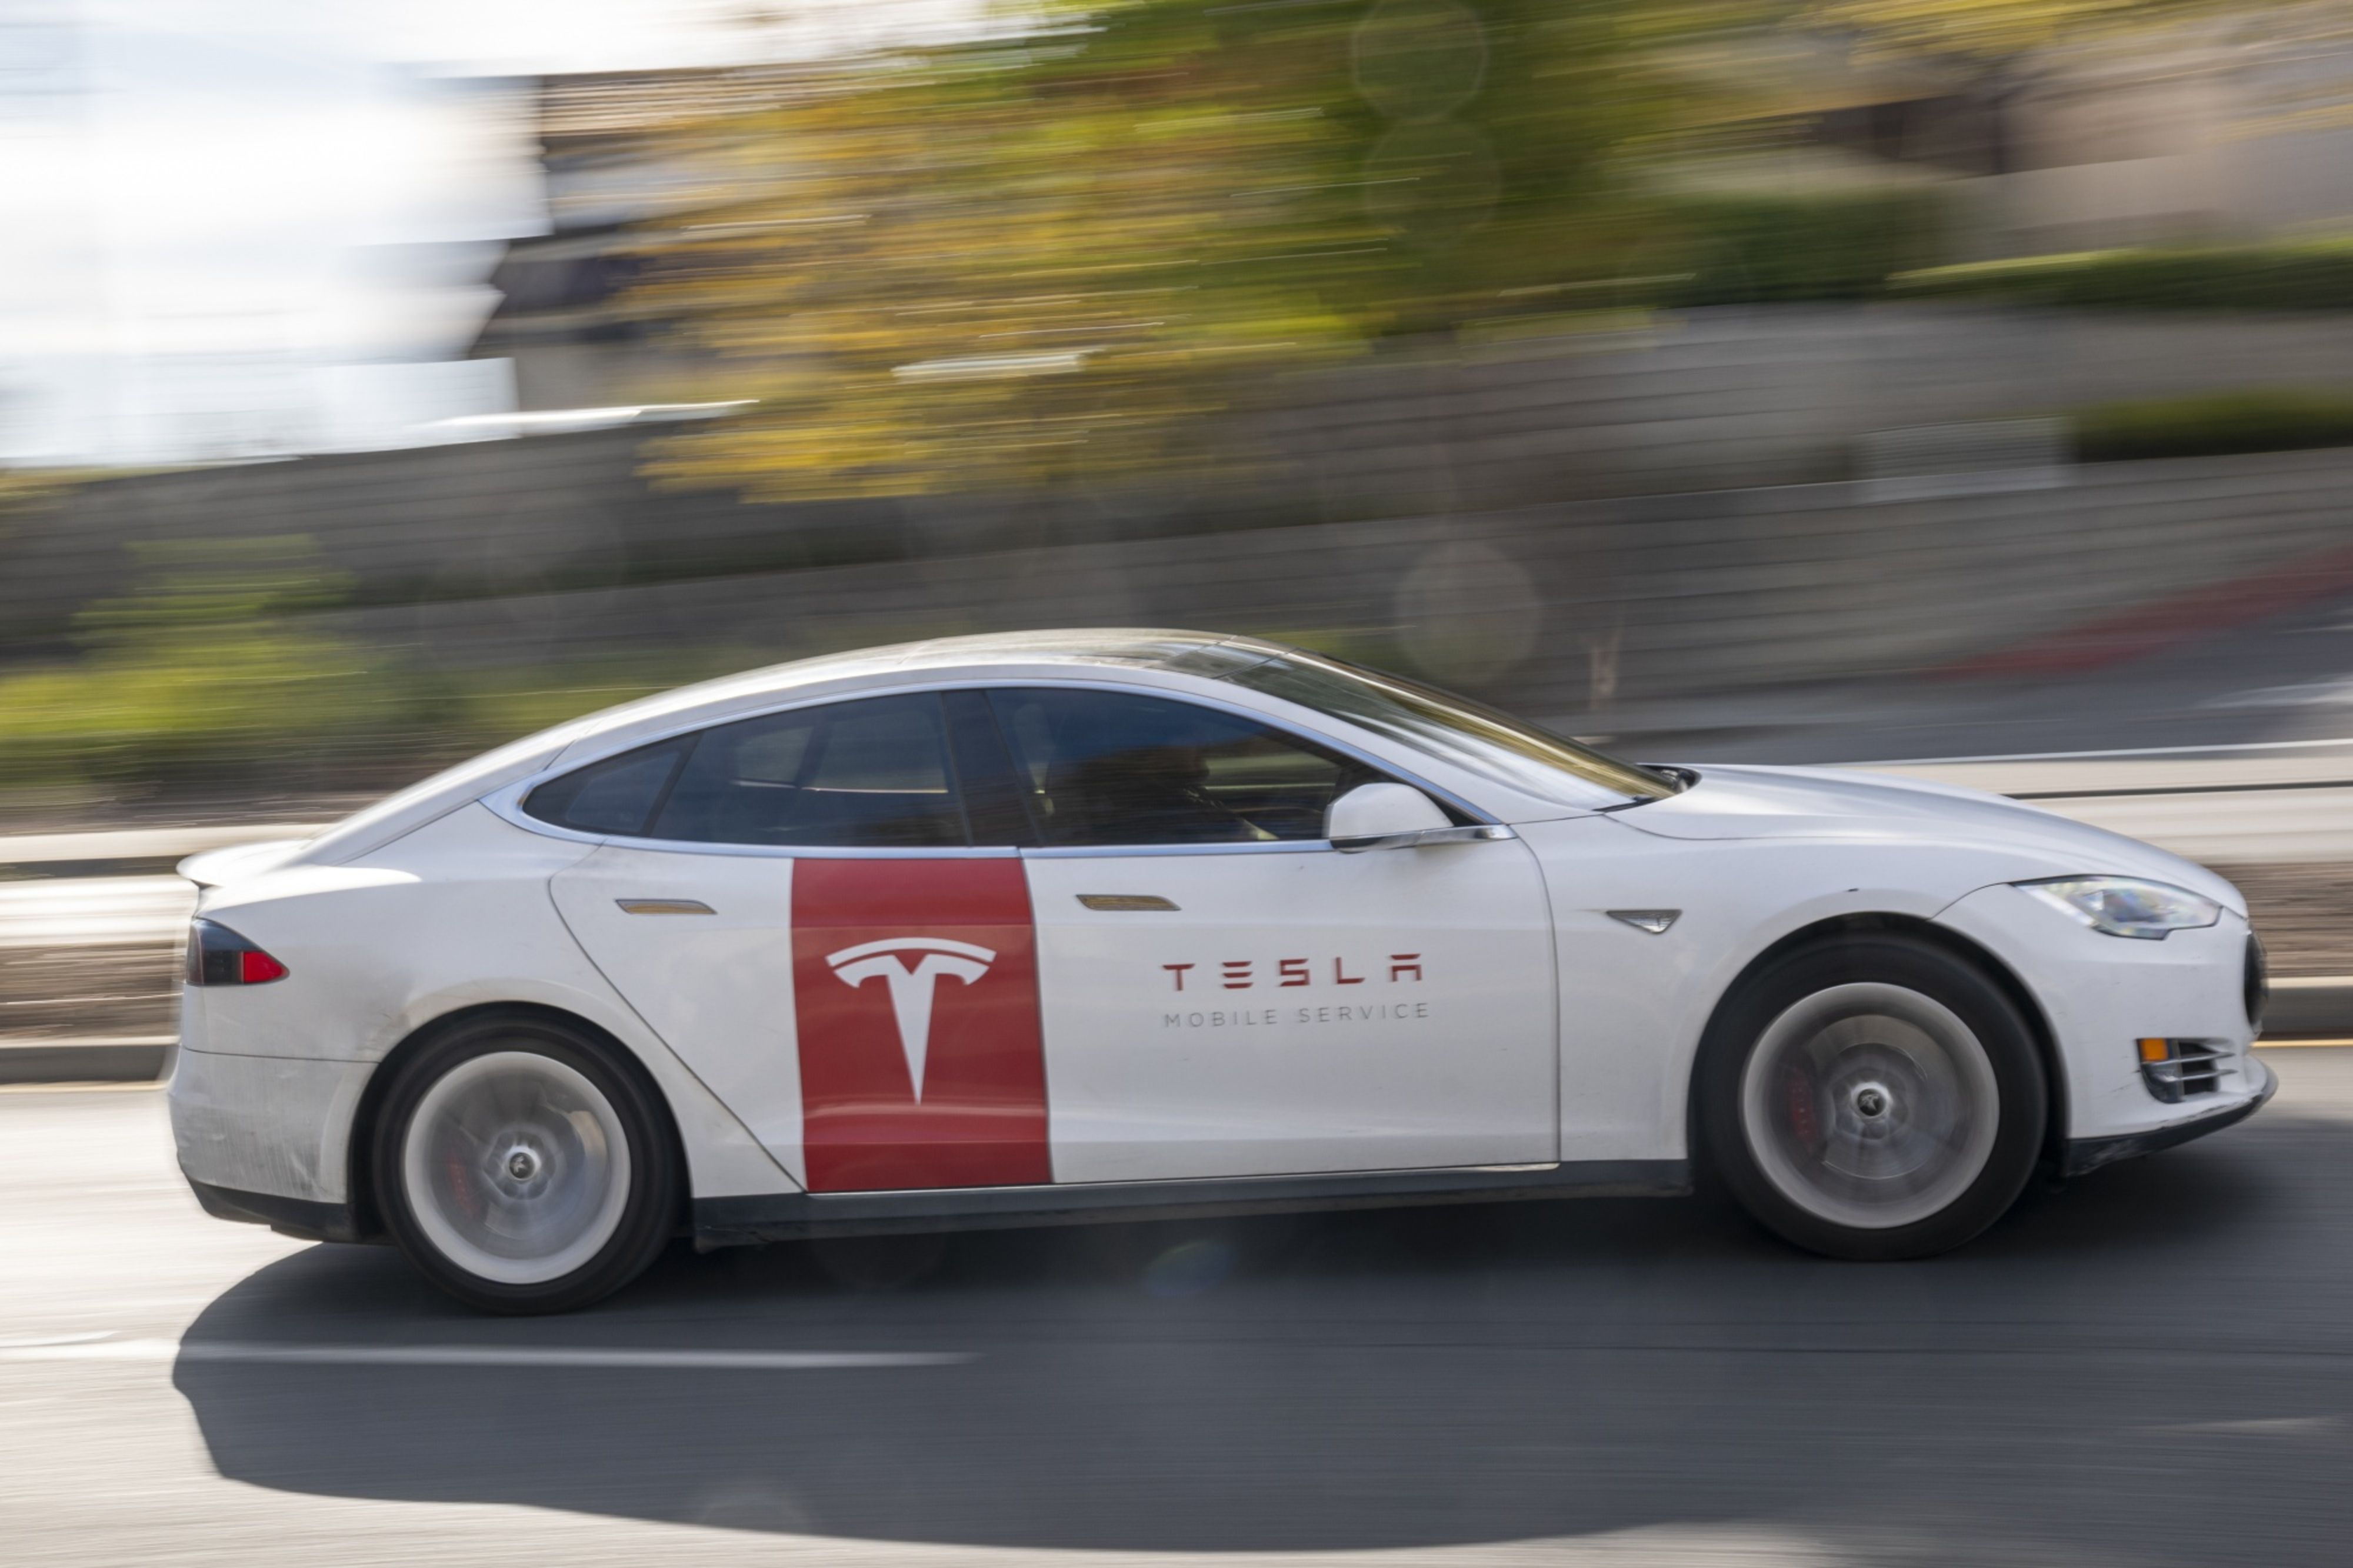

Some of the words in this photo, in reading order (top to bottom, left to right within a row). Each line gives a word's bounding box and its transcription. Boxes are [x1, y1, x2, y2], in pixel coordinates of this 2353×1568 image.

[1162, 953, 1422, 992] TESLA
[1163, 1009, 1278, 1028] MOBILE
[1298, 1002, 1430, 1023] SERVICE
